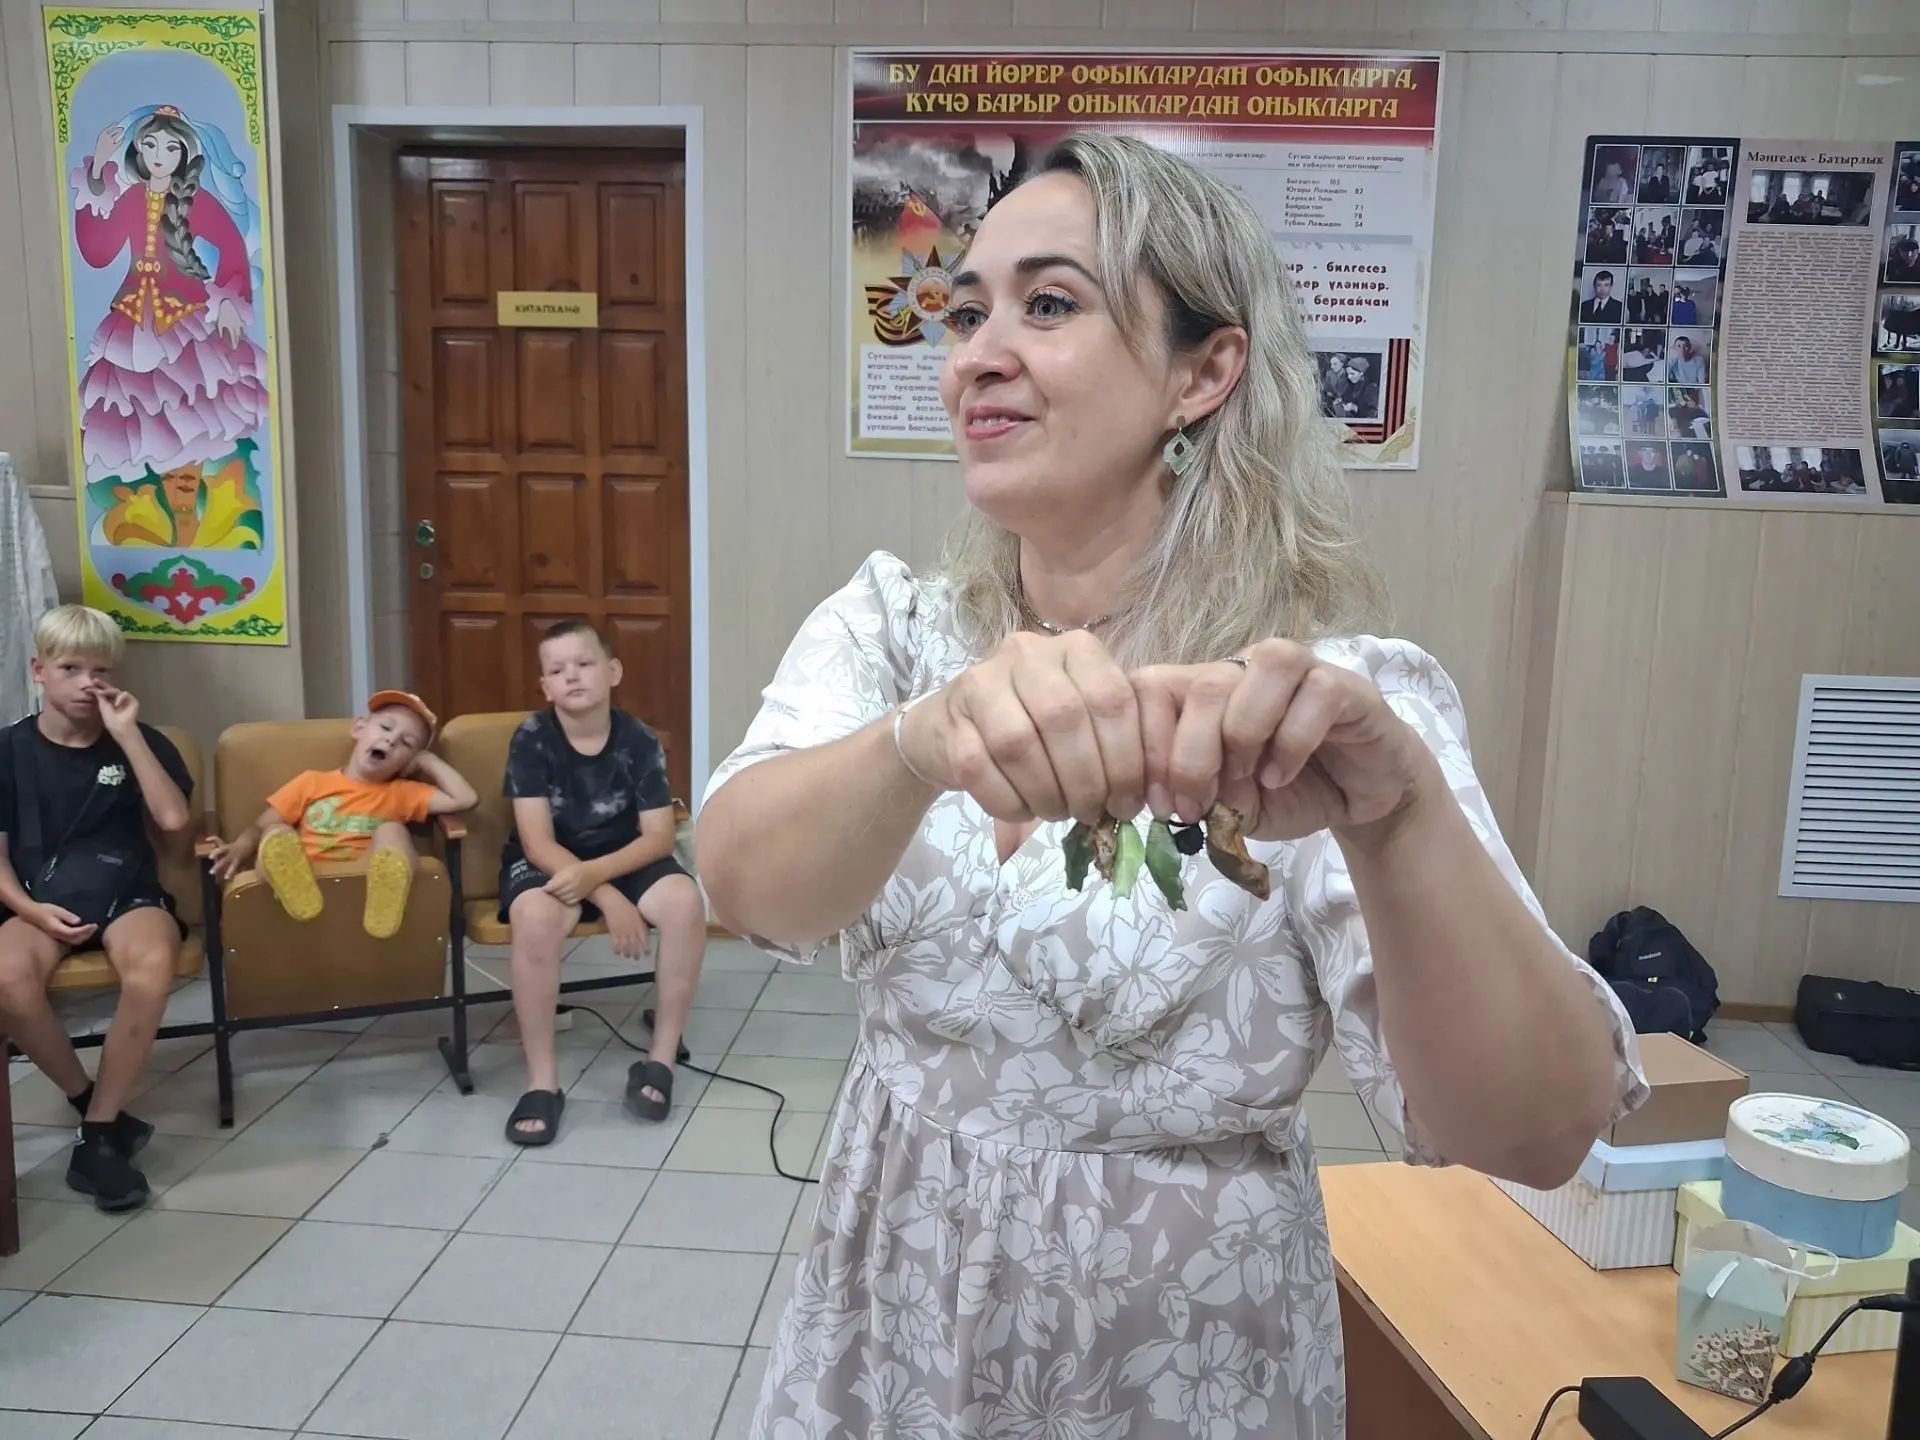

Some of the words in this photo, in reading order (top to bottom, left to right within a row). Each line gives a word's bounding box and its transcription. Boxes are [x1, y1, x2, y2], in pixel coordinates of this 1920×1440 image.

[889, 63, 920, 84] БУ
[927, 64, 978, 88] ДАН
[985, 61, 1064, 85] ЙӨРЕР
[1070, 64, 1247, 89] ОФЫКЛАРДАН
[1255, 67, 1417, 90] ОФЫКЛАРГА,
[905, 93, 970, 113] КҮЧӘ
[976, 93, 1061, 113] БАРЫР
[1067, 93, 1240, 119] ОНЫКЛАРДАН
[1246, 95, 1399, 118] ОНЫКЛАРГА
[1818, 153, 1884, 167] Батырлык
[1326, 261, 1387, 273] билгесез
[1328, 280, 1389, 292] үләннәр.
[1313, 294, 1389, 307] беркайчан
